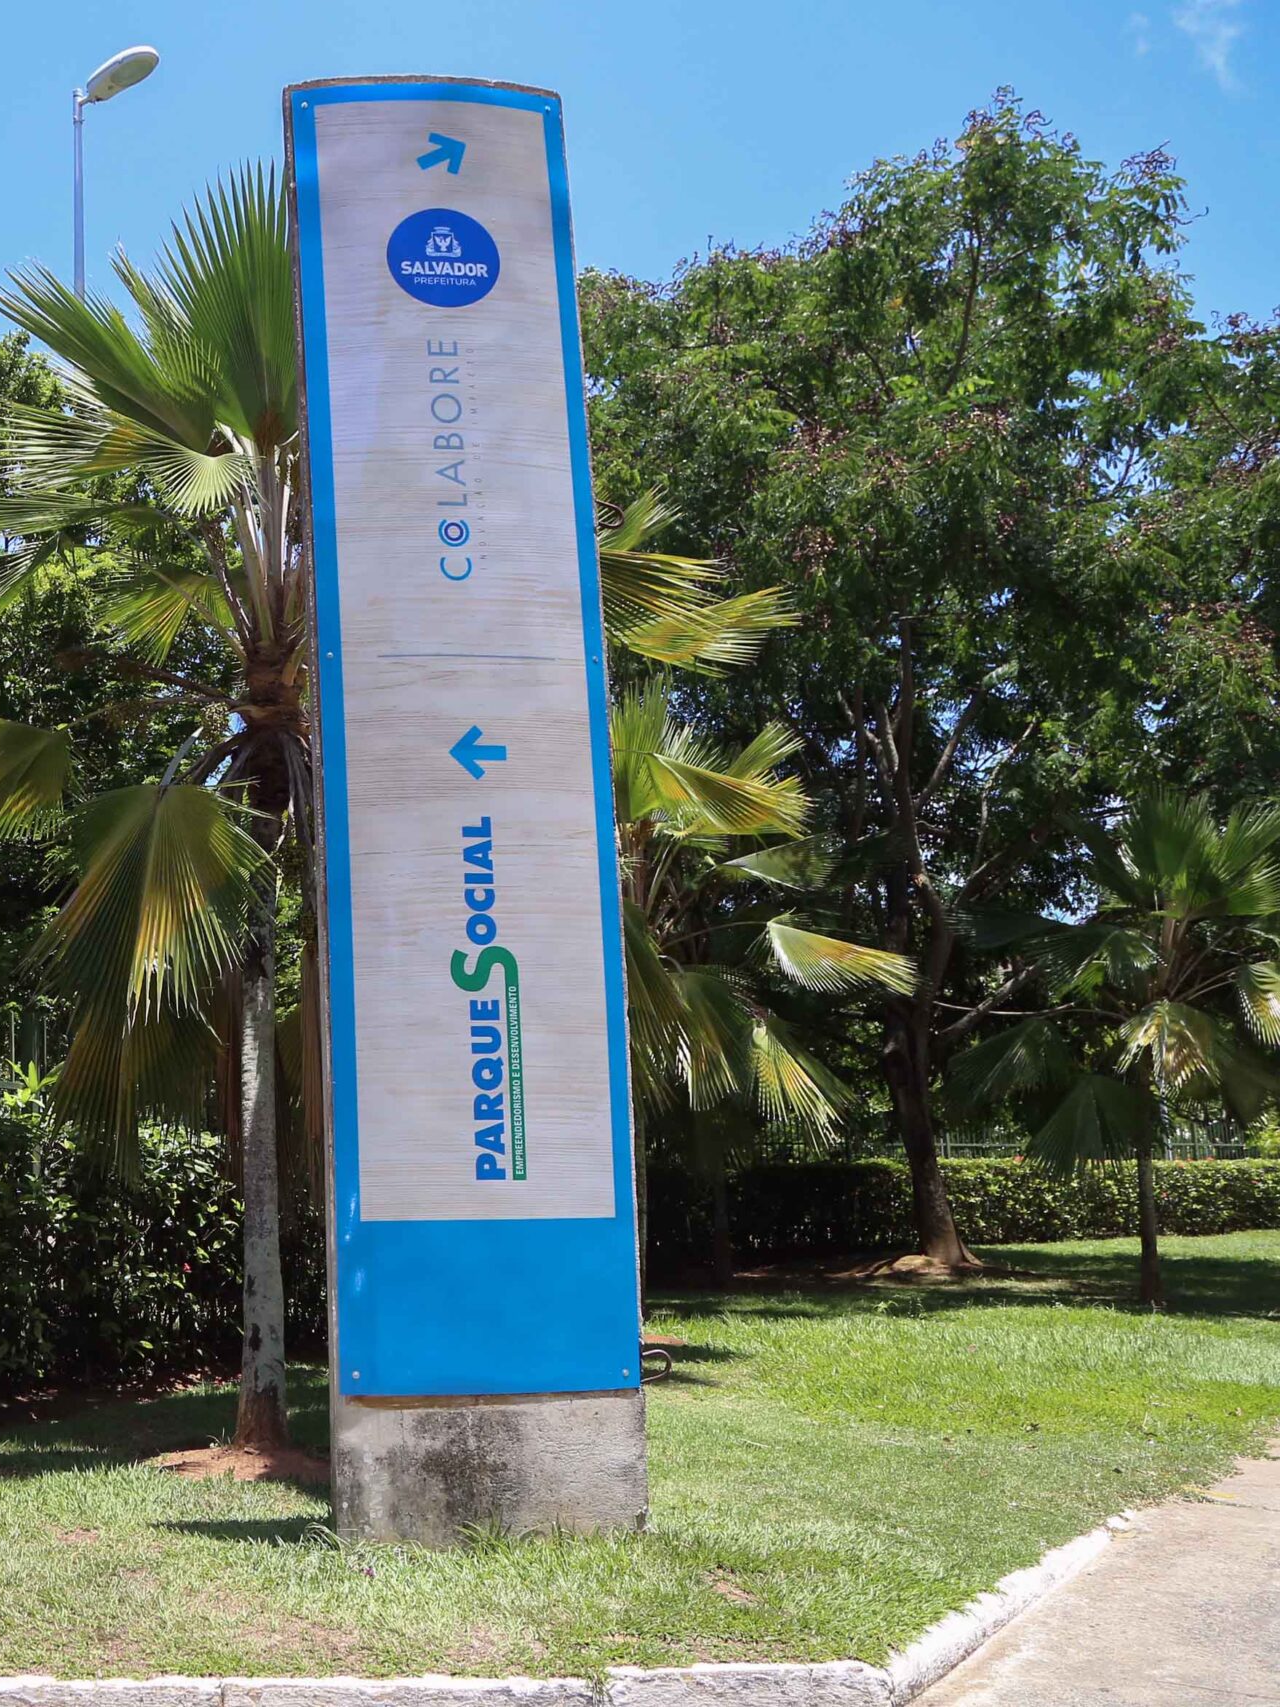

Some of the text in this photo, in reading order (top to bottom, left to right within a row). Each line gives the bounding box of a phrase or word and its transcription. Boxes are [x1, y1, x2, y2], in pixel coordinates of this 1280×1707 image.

[400, 261, 489, 278] SALVADOR
[414, 277, 477, 286] PREFEITURA
[466, 348, 478, 424] IMPACTO
[472, 443, 482, 460] DE
[450, 816, 519, 1181] PARQUE SOCIAL
[508, 986, 520, 1070] DESENVOLVIMENTO
[512, 1079, 524, 1175] EMPREENDEDORISMO
